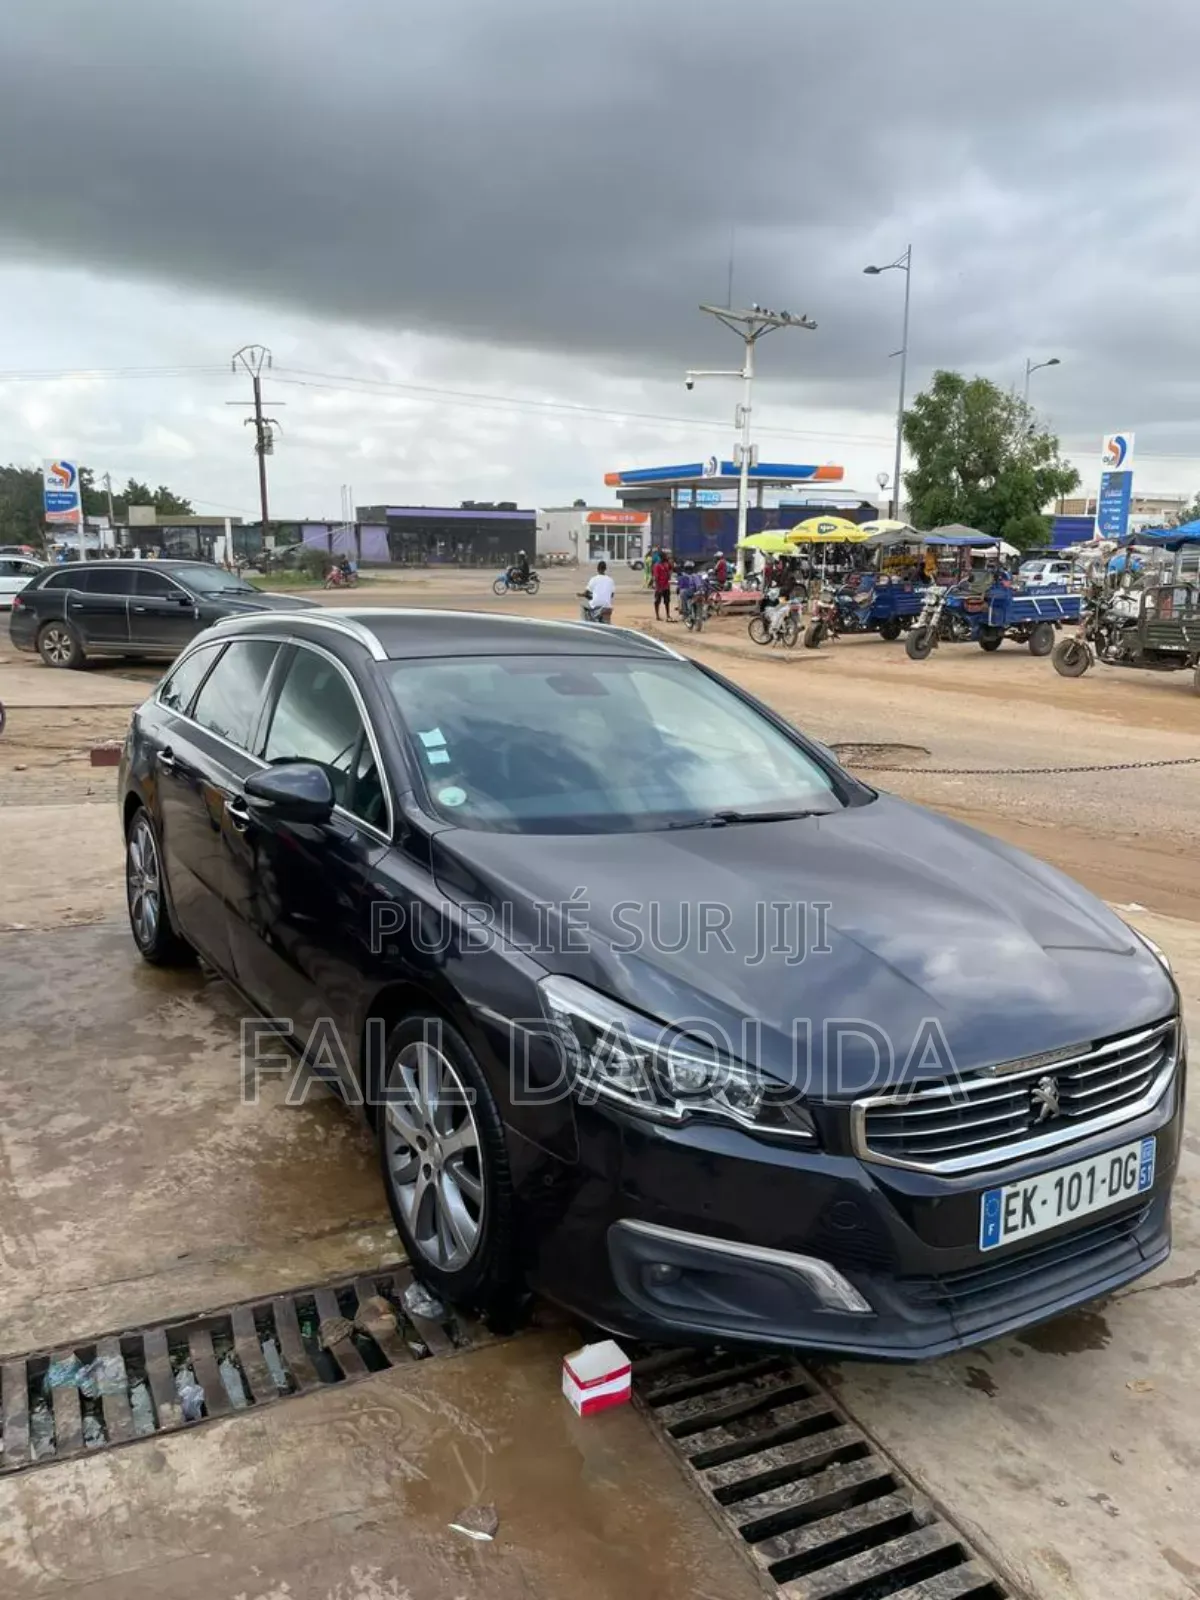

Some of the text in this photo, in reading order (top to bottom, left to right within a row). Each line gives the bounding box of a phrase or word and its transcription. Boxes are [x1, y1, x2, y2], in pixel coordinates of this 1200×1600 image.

[1140, 1165, 1152, 1185] 51
[1004, 1152, 1137, 1234] EK-101-DG
[987, 1223, 995, 1237] F
